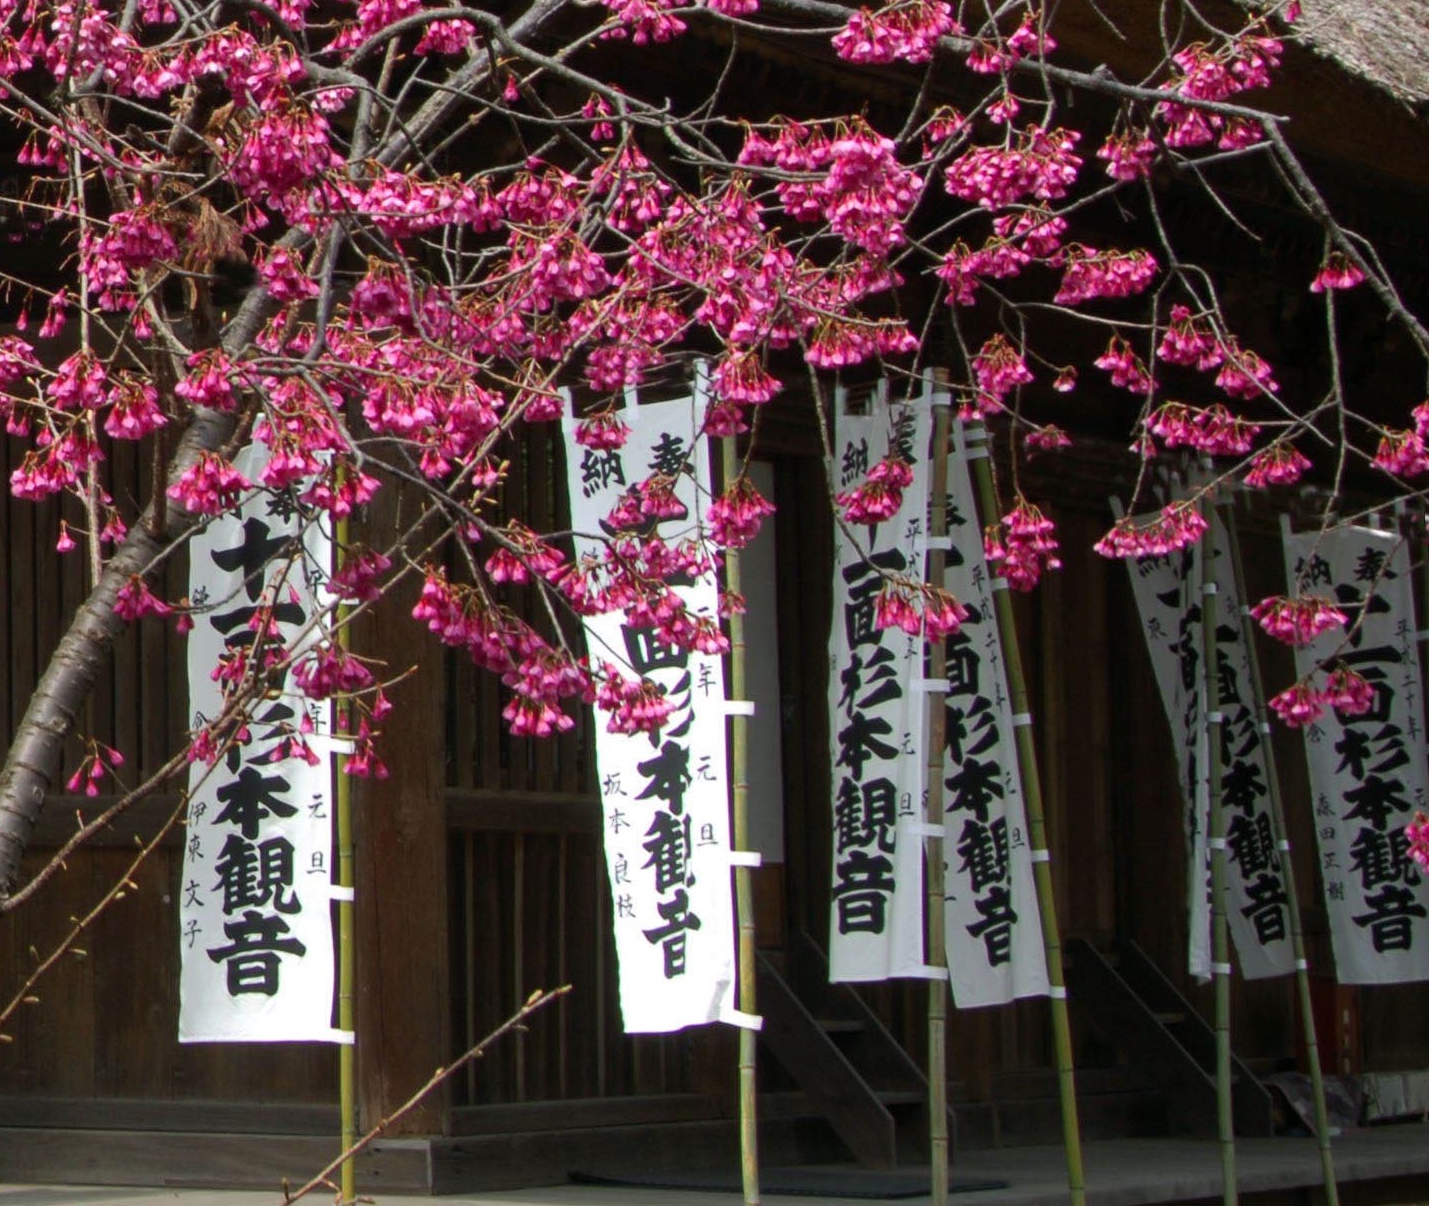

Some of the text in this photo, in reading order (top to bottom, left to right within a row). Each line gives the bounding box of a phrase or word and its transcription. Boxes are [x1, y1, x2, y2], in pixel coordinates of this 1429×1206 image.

[580, 431, 695, 497] 奉納
[1294, 546, 1398, 589] 奉納
[695, 754, 721, 849] 元旦
[896, 731, 917, 819] 元旦
[183, 800, 209, 951] 伊東文子
[306, 792, 328, 877] 元旦
